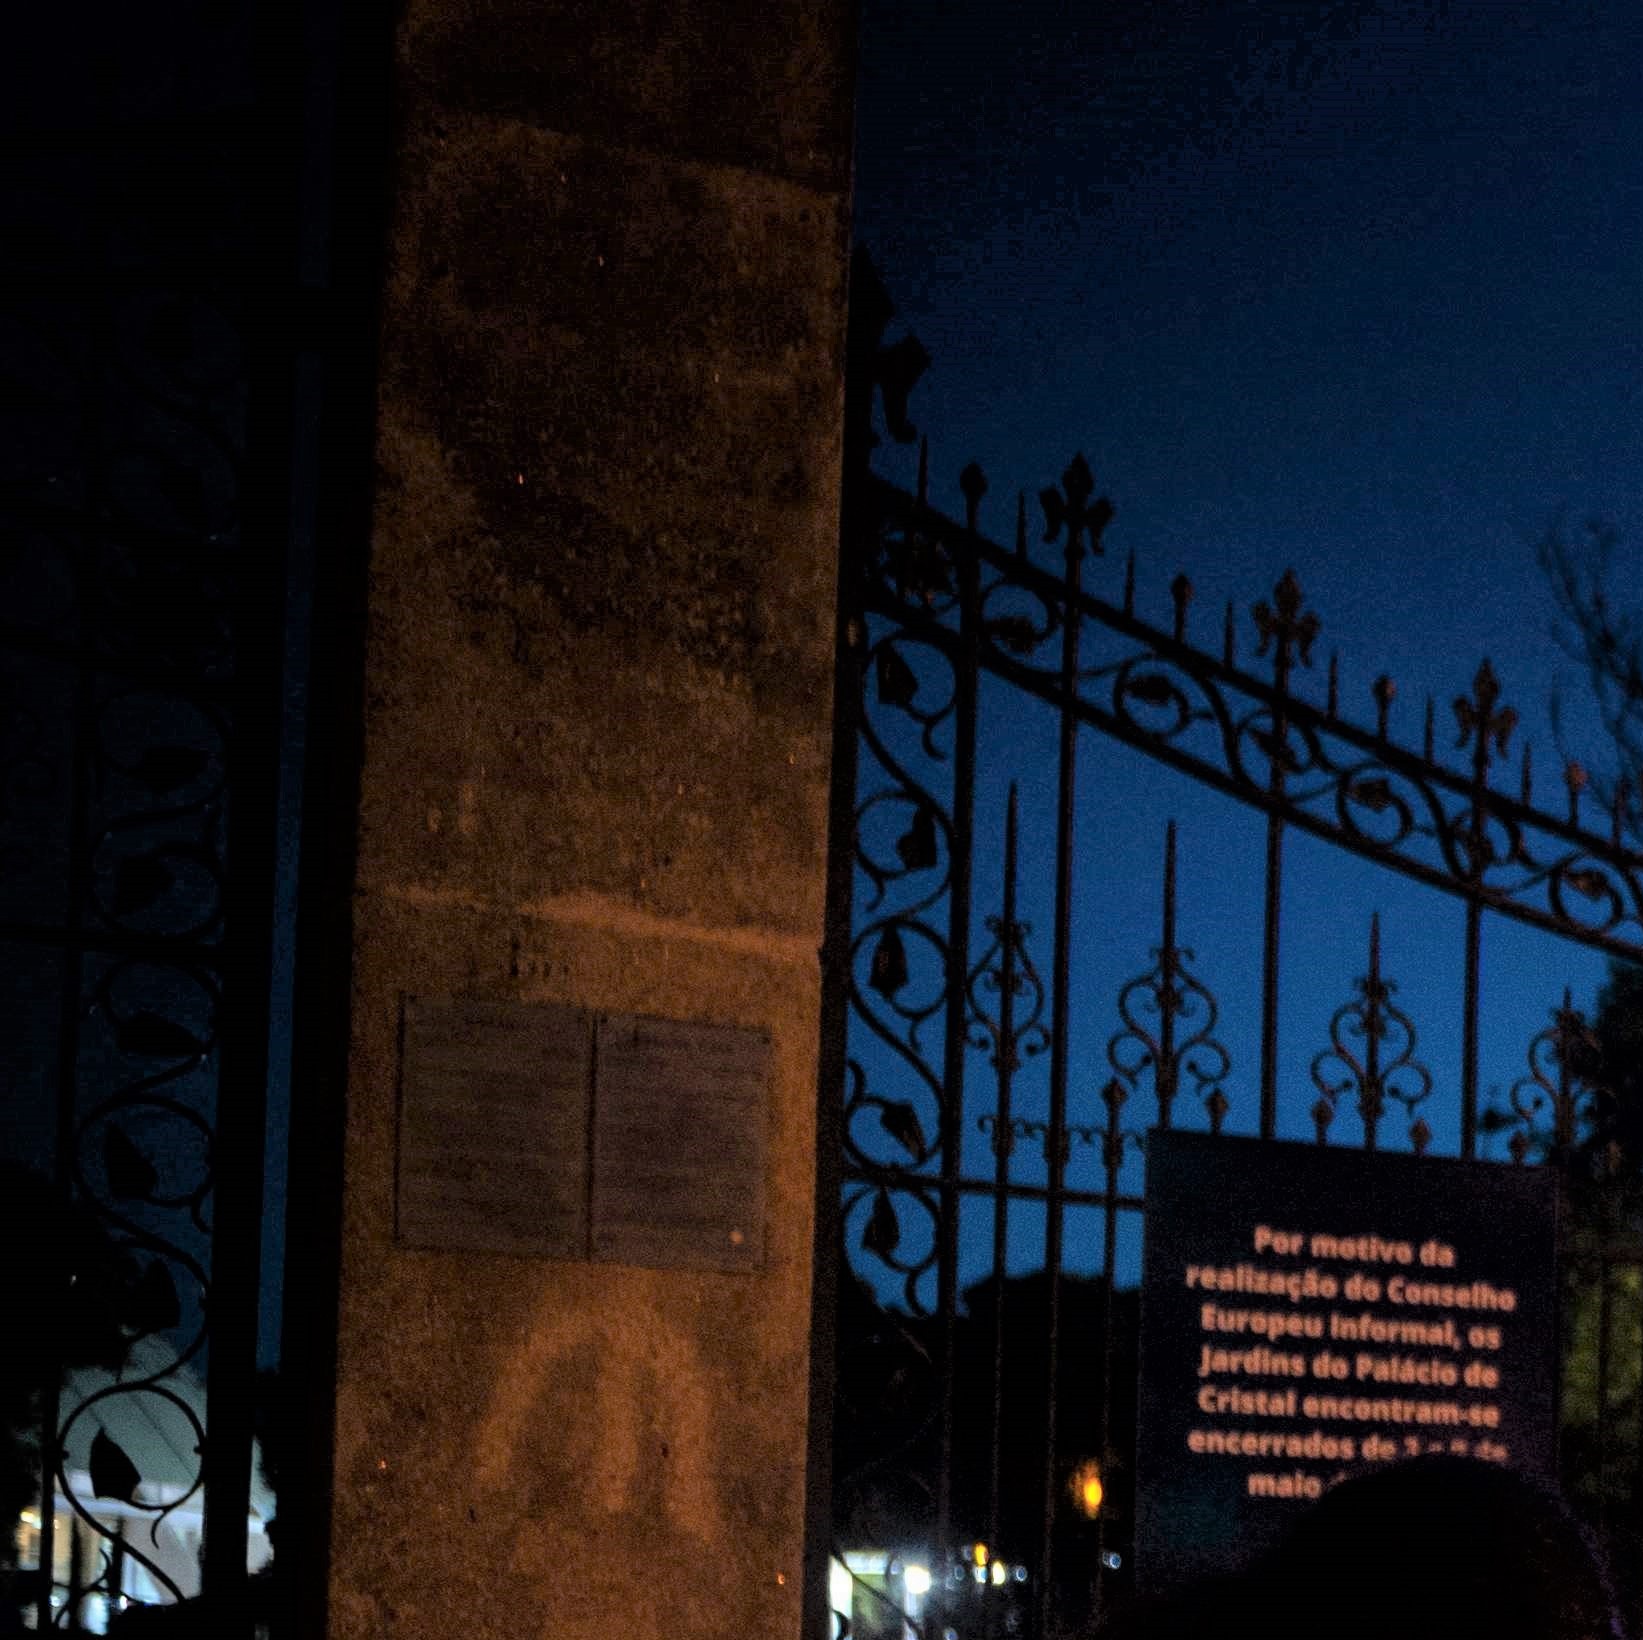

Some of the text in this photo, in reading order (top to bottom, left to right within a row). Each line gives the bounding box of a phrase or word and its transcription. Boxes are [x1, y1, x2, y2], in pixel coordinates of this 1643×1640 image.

[1254, 1226, 1455, 1267] Por motivo da
[1185, 1265, 1517, 1311] realização do Conselho
[1202, 1303, 1502, 1351] Europeu Informal, os
[1198, 1345, 1500, 1389] Jardins do Palácio de
[1198, 1386, 1500, 1428] Cristal encontram-se
[1188, 1430, 1354, 1459] encerrados
[1362, 1436, 1397, 1462] de
[1248, 1471, 1322, 1499] maio
